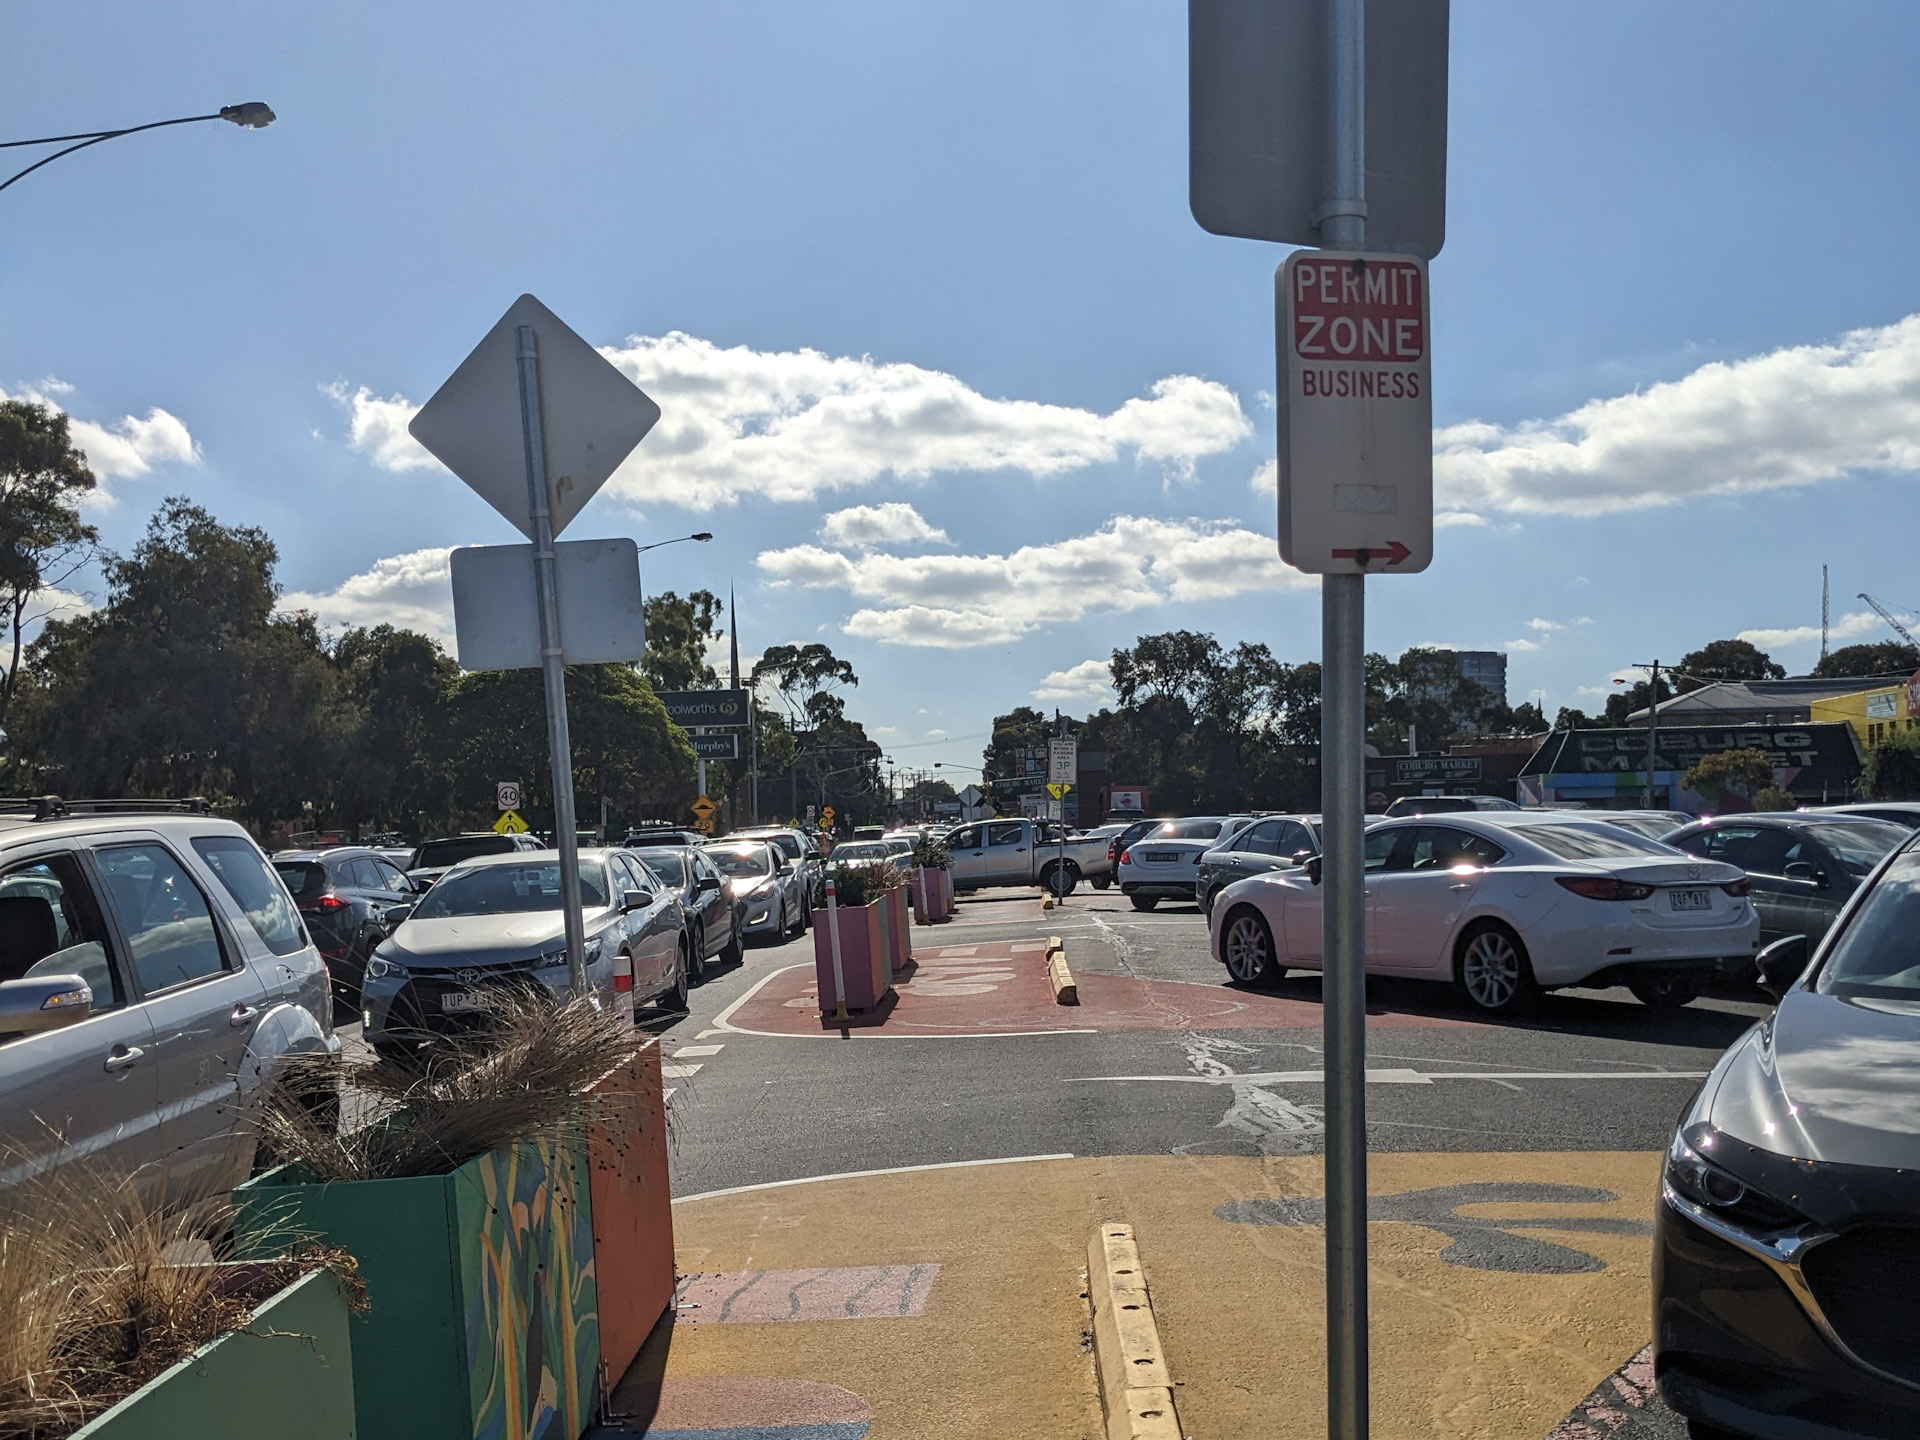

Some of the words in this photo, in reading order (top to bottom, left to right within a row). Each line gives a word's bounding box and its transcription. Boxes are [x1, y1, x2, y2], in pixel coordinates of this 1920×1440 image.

[1297, 265, 1417, 306] PERMIT
[1298, 315, 1420, 356] ZONE
[1302, 369, 1420, 399] BUSINESS
[666, 702, 717, 715] oolworths
[1581, 732, 1812, 751] COBURG
[1057, 761, 1070, 770] 3P
[1400, 762, 1437, 770] COBURG
[1440, 760, 1478, 769] MARKET
[1582, 751, 1818, 770] MAET
[501, 791, 516, 800] 40
[698, 821, 710, 829] 20
[443, 994, 463, 1007] 1UP
